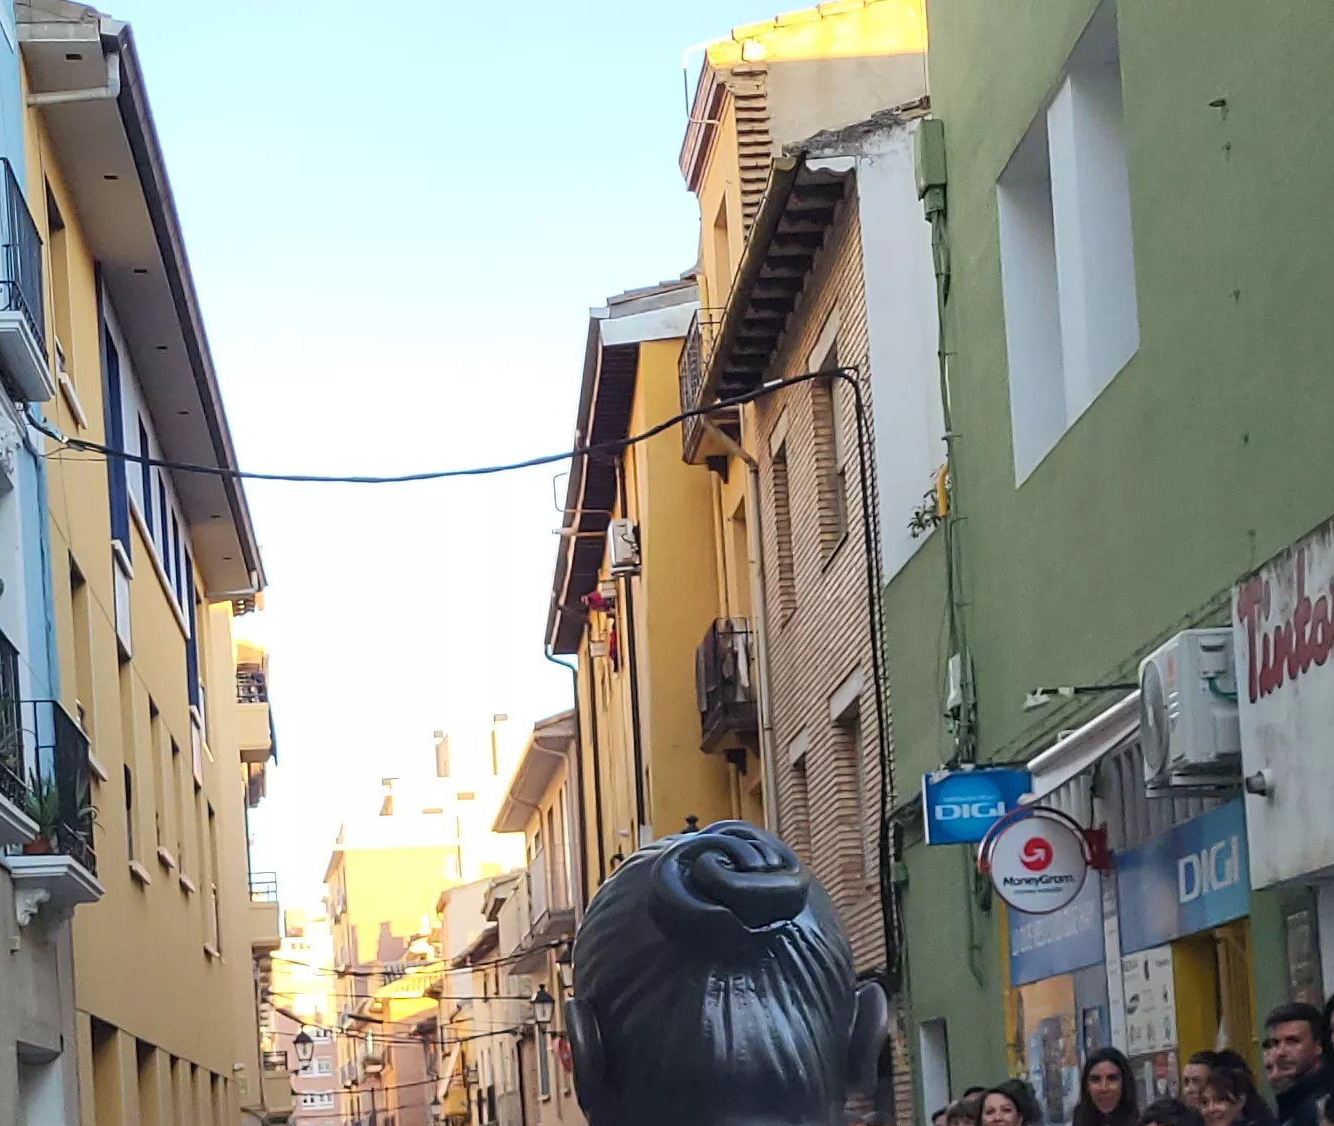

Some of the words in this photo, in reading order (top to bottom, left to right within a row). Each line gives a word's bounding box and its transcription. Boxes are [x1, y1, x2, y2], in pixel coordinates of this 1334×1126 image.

[934, 801, 1006, 821] DIGI
[1178, 835, 1240, 903] DIGI
[1003, 873, 1073, 887] MoneyGram
